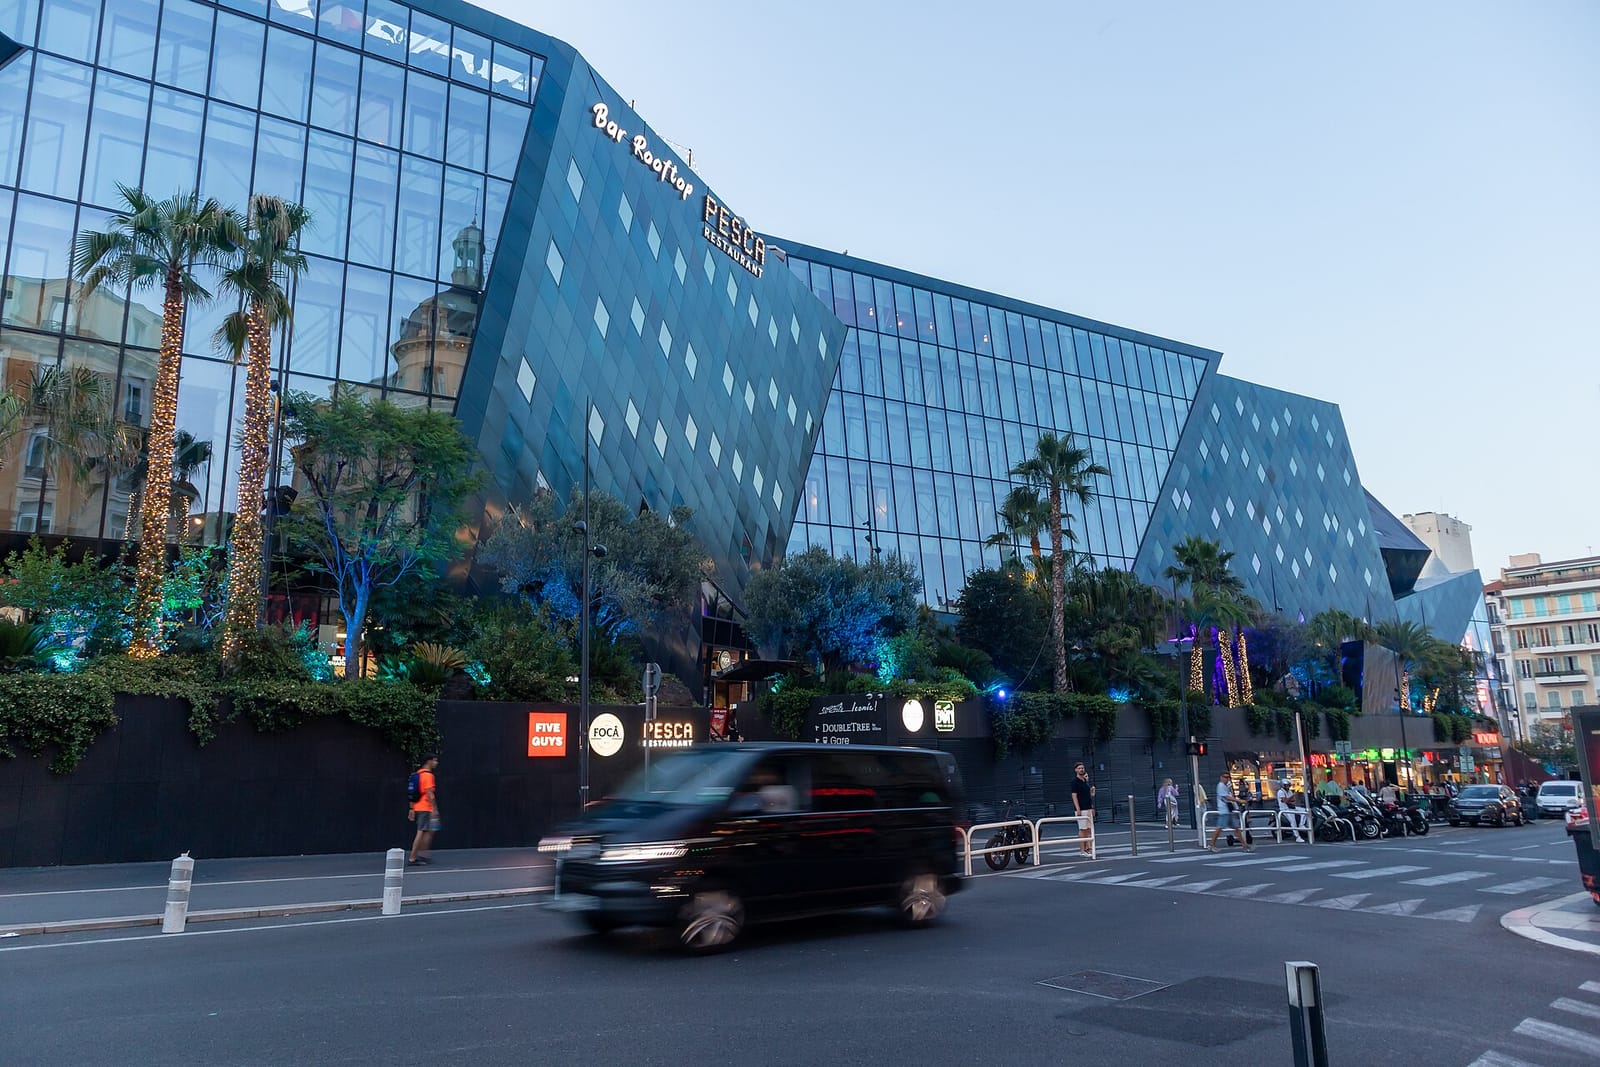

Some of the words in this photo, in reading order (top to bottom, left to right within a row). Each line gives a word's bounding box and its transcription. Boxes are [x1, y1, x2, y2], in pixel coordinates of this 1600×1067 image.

[592, 103, 628, 142] Bar
[633, 135, 694, 200] Rooftop
[705, 195, 765, 265] PESCA
[704, 226, 763, 279] RESTAURANT
[535, 722, 561, 733] FIVE
[643, 722, 693, 739] PESCA
[531, 736, 563, 747] GUYS
[830, 736, 850, 745] Gare
